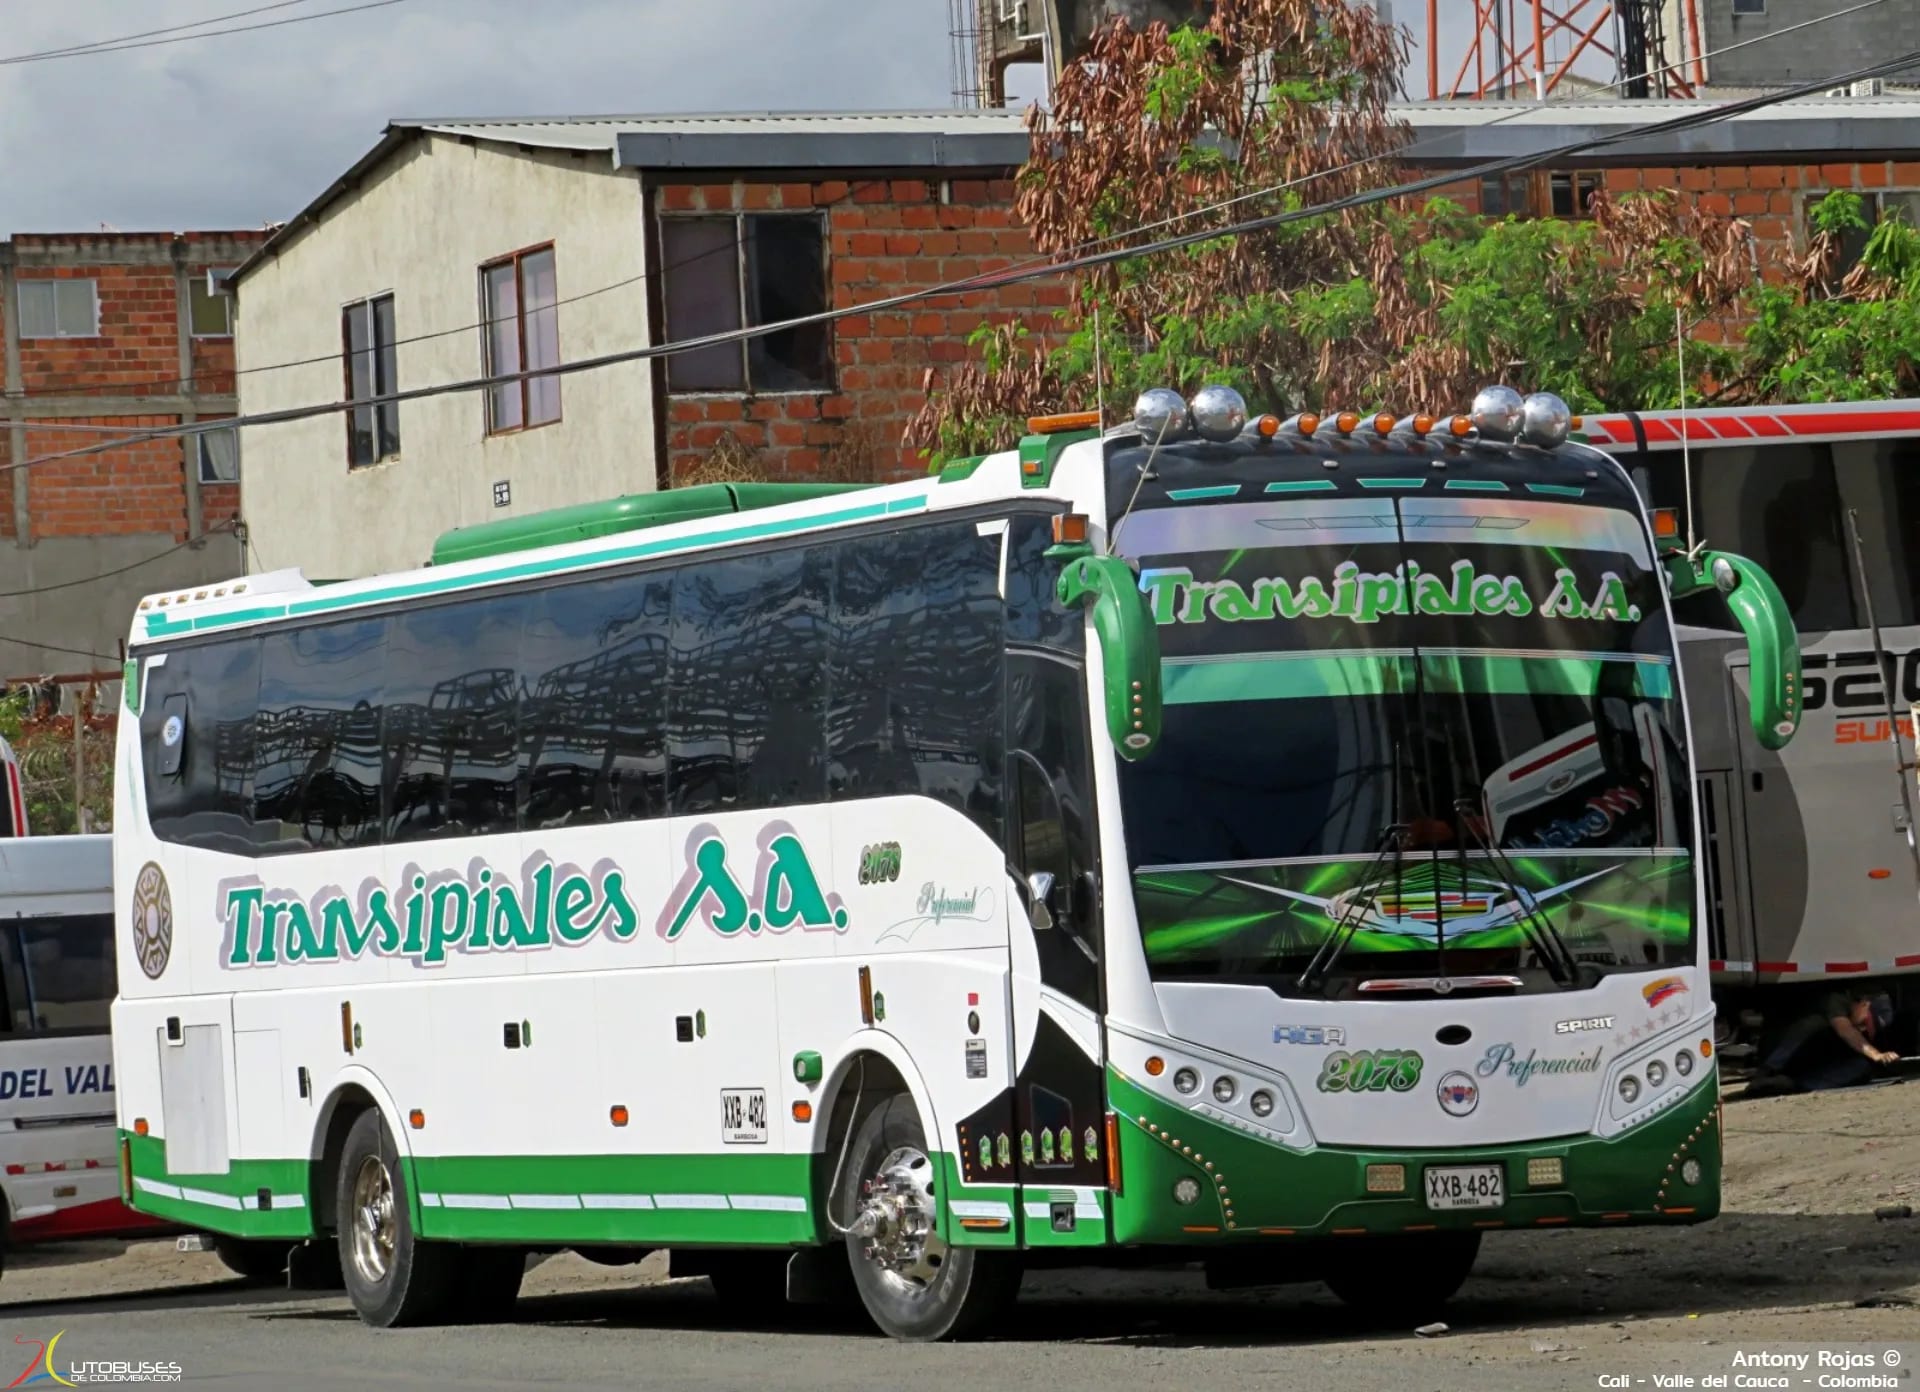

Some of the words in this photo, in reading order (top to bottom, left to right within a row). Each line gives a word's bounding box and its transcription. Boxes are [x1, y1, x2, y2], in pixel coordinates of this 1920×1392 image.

[1140, 559, 1532, 623] Transipiales
[1540, 568, 1642, 622] S.A.
[224, 858, 639, 966] Transipiales
[1555, 1015, 1616, 1034] SPIRIT
[0, 1068, 54, 1099] DEL
[1316, 1049, 1424, 1093] 2078
[1477, 1042, 1603, 1088] Preferencial
